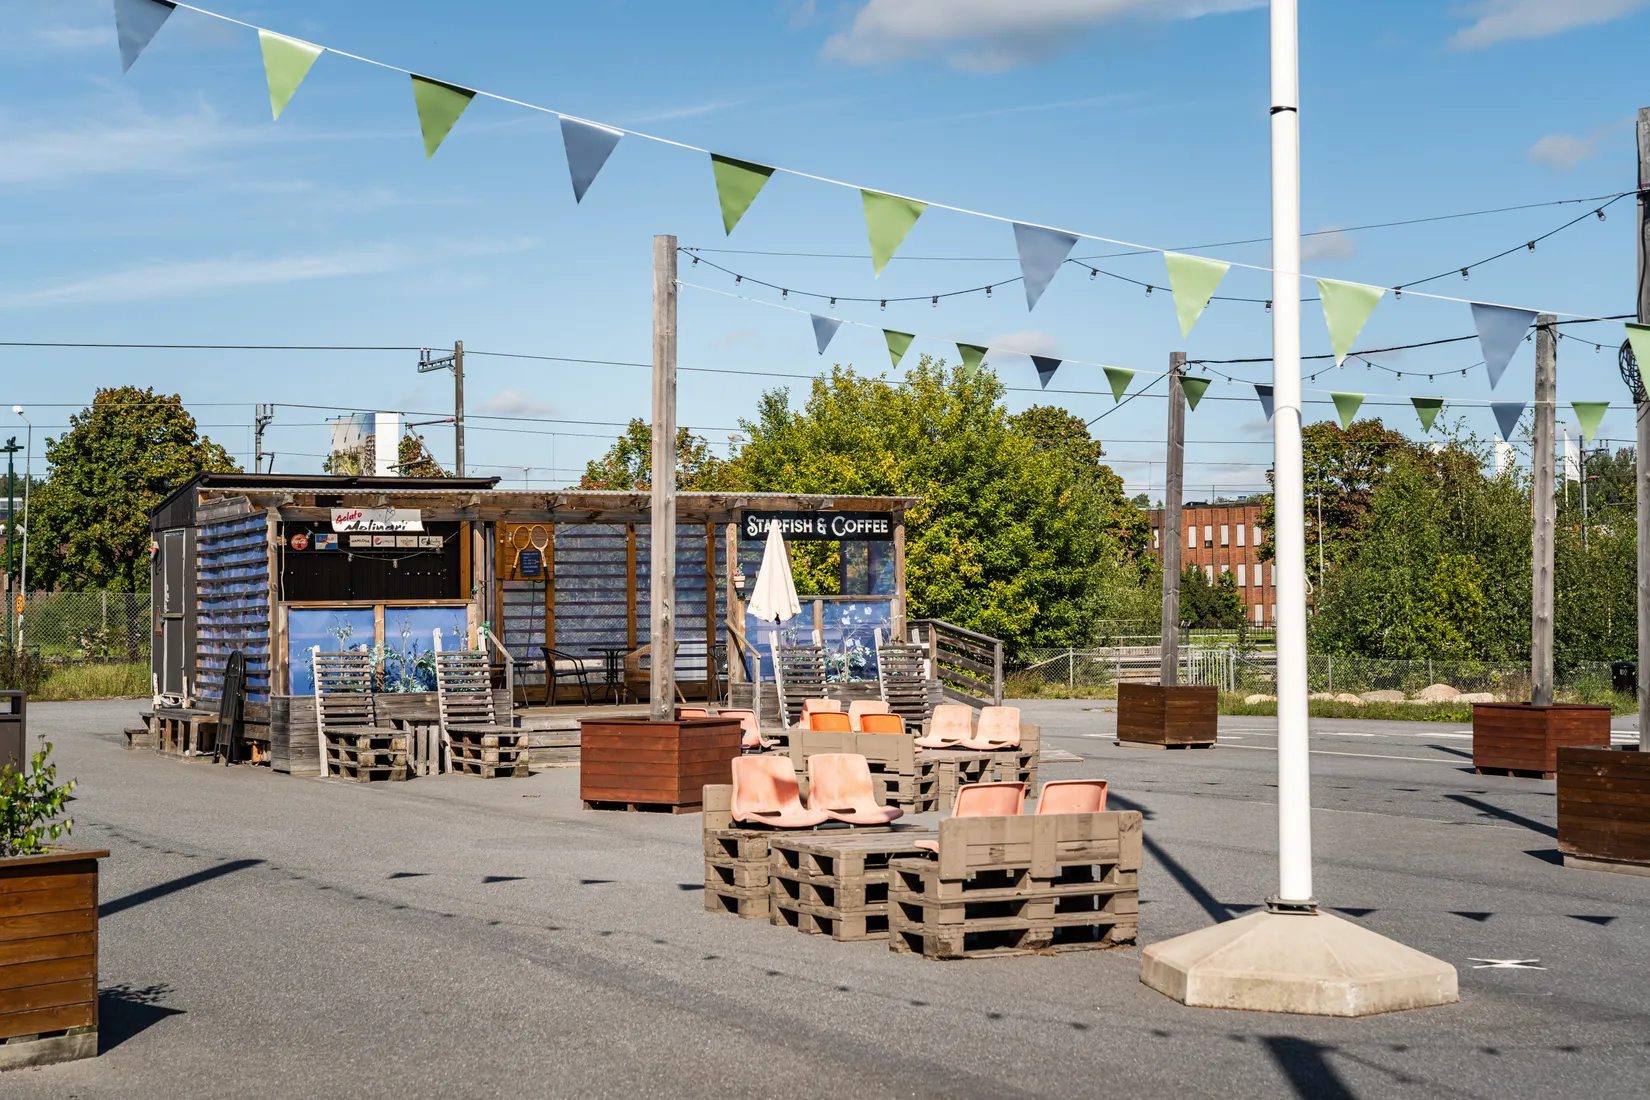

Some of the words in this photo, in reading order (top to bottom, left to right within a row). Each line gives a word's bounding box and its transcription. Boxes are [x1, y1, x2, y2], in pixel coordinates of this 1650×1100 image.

[336, 510, 362, 524] Gelato
[344, 519, 408, 531] Molinari
[817, 517, 827, 535] &
[831, 515, 888, 537] COFFEE
